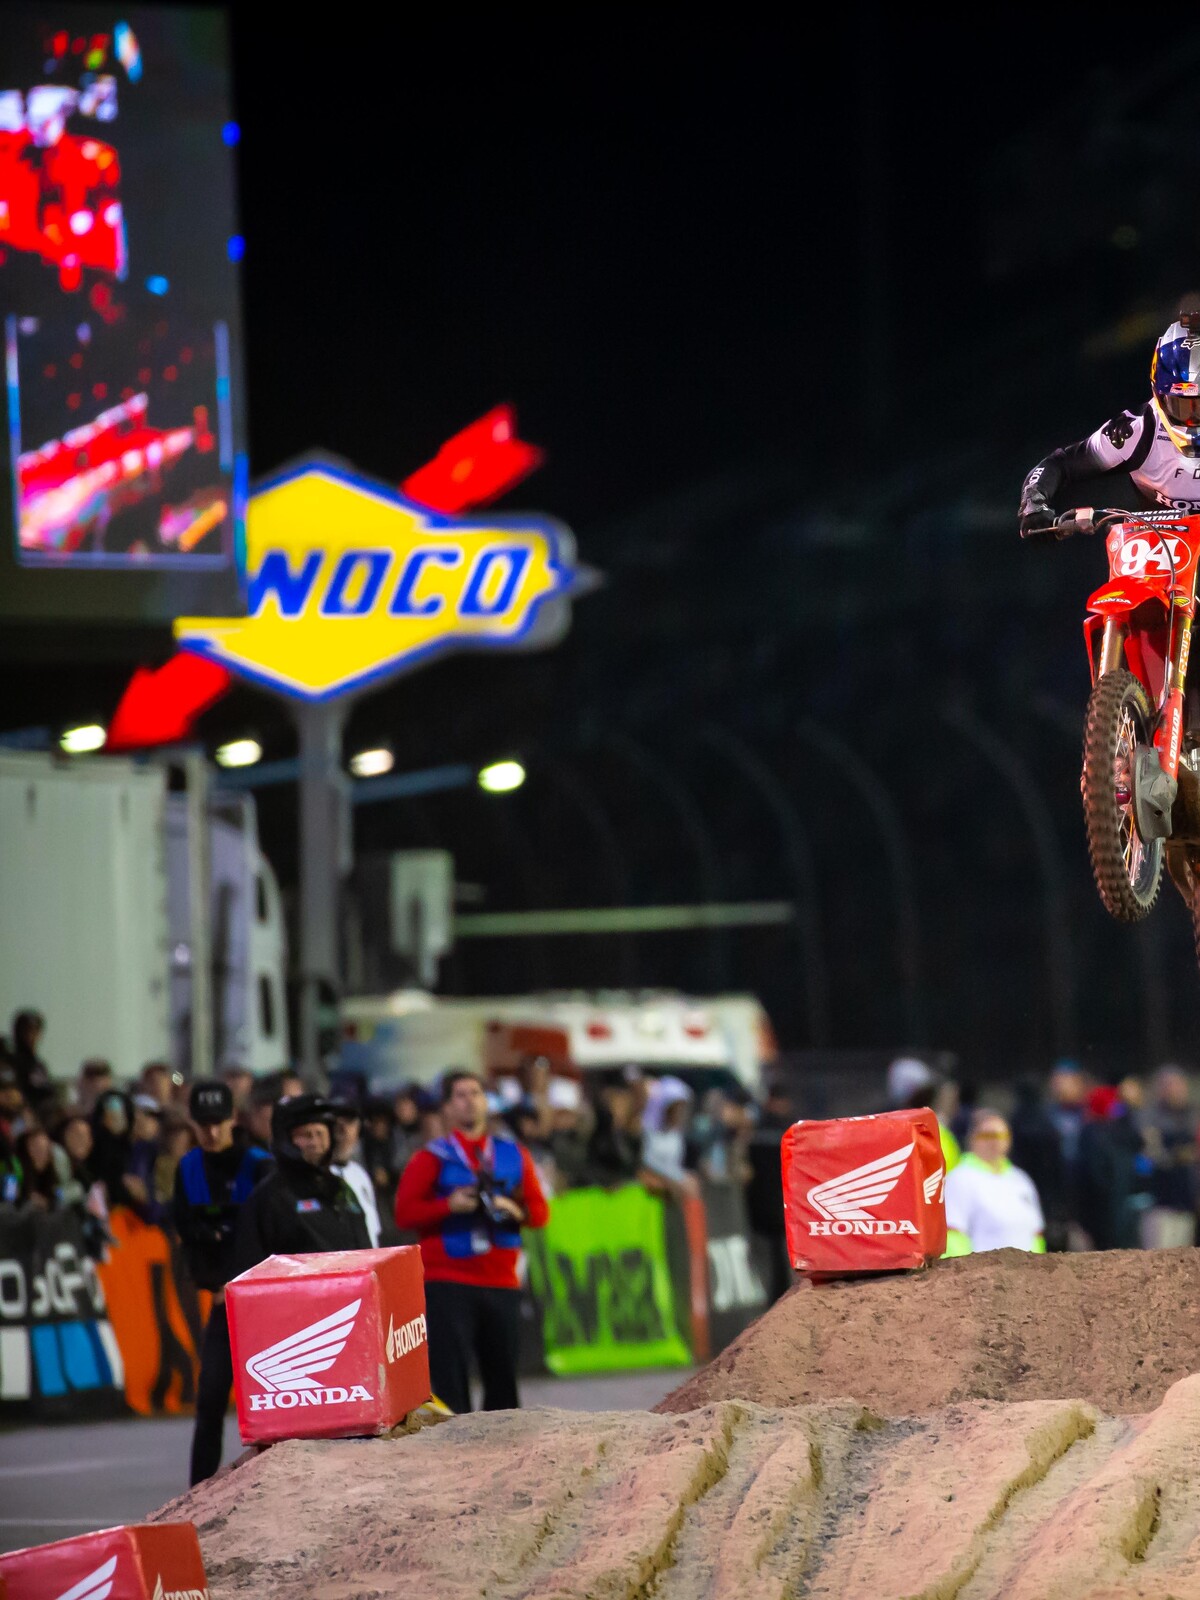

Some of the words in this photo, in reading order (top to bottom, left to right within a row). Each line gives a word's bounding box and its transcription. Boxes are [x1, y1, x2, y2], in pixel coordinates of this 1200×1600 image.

[1120, 538, 1181, 576] 94
[249, 546, 534, 617] NOCO
[1169, 707, 1181, 761] DUNLOP
[808, 1219, 921, 1236] HONDA
[394, 1313, 428, 1359] HONDA
[250, 1384, 374, 1412] HONDA
